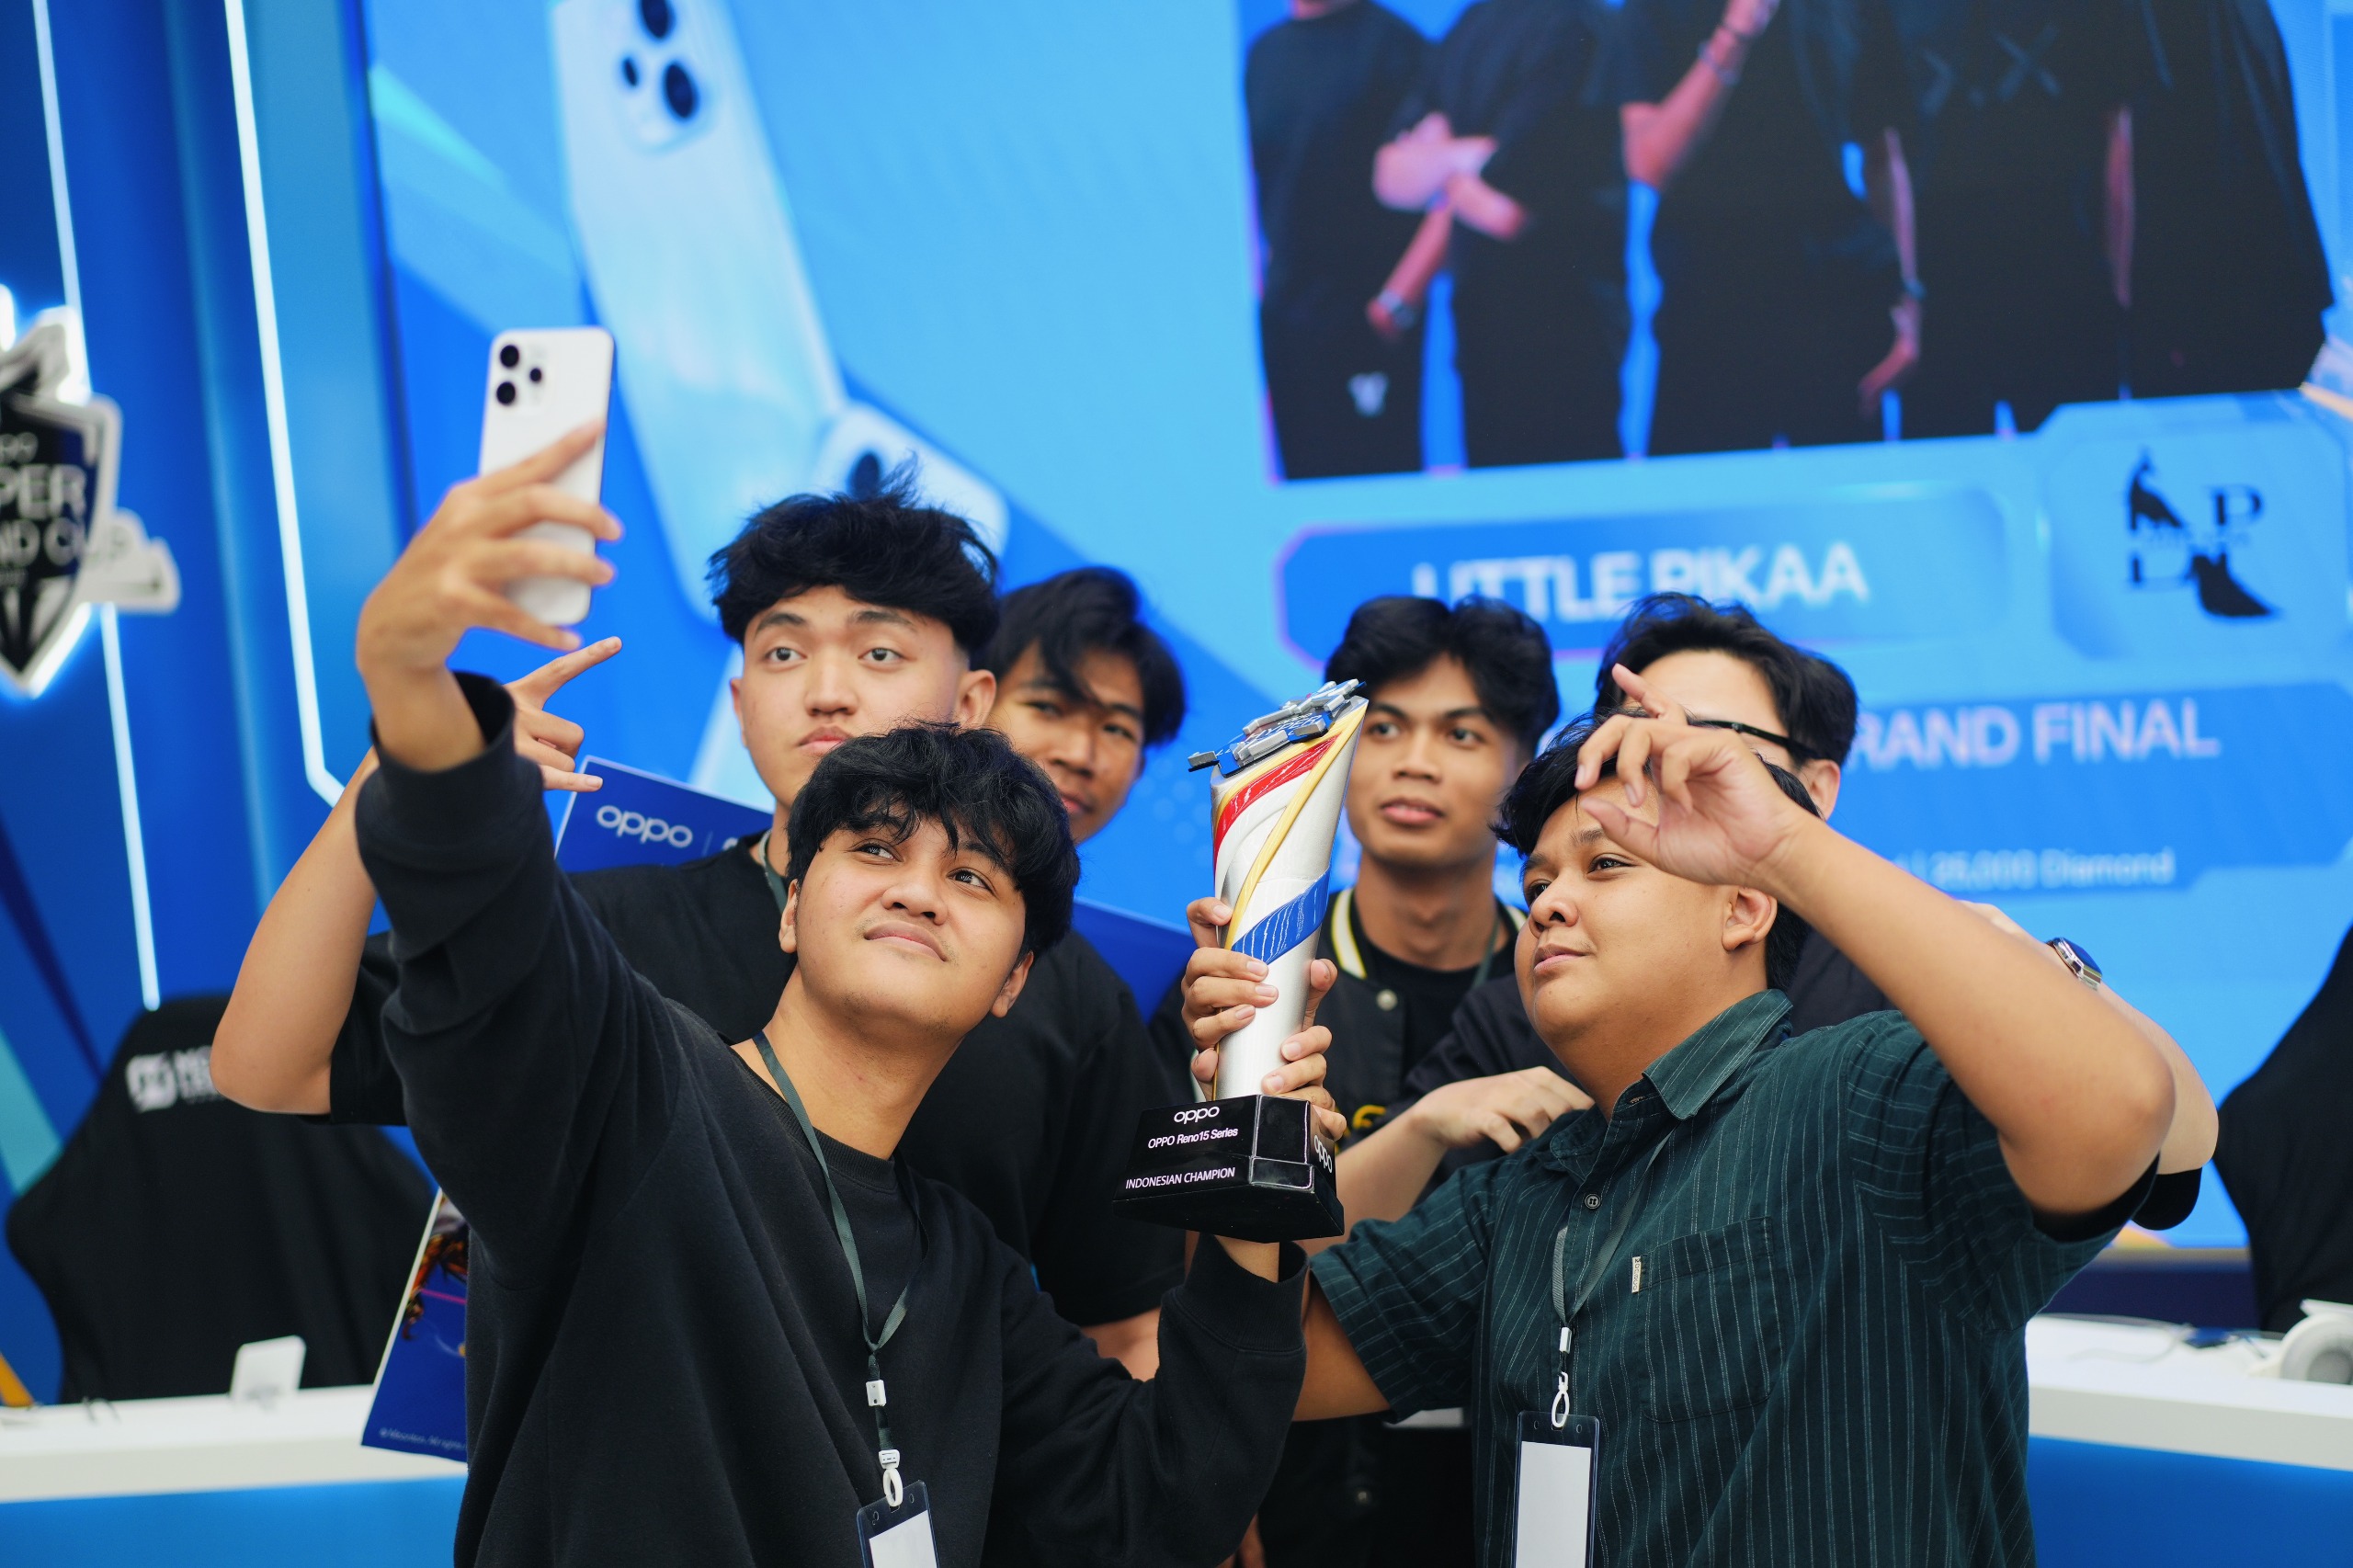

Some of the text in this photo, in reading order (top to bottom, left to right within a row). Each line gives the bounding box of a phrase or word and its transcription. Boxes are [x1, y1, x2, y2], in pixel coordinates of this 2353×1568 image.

[1849, 699, 2221, 770] RAND FINAL
[597, 805, 693, 847] oppo
[1174, 1106, 1220, 1124] oppo
[1148, 1127, 1239, 1149] OPPO Reno15 Series
[1313, 1134, 1333, 1174] oppo
[1125, 1166, 1236, 1189] INDONESIAN CHAMPION
